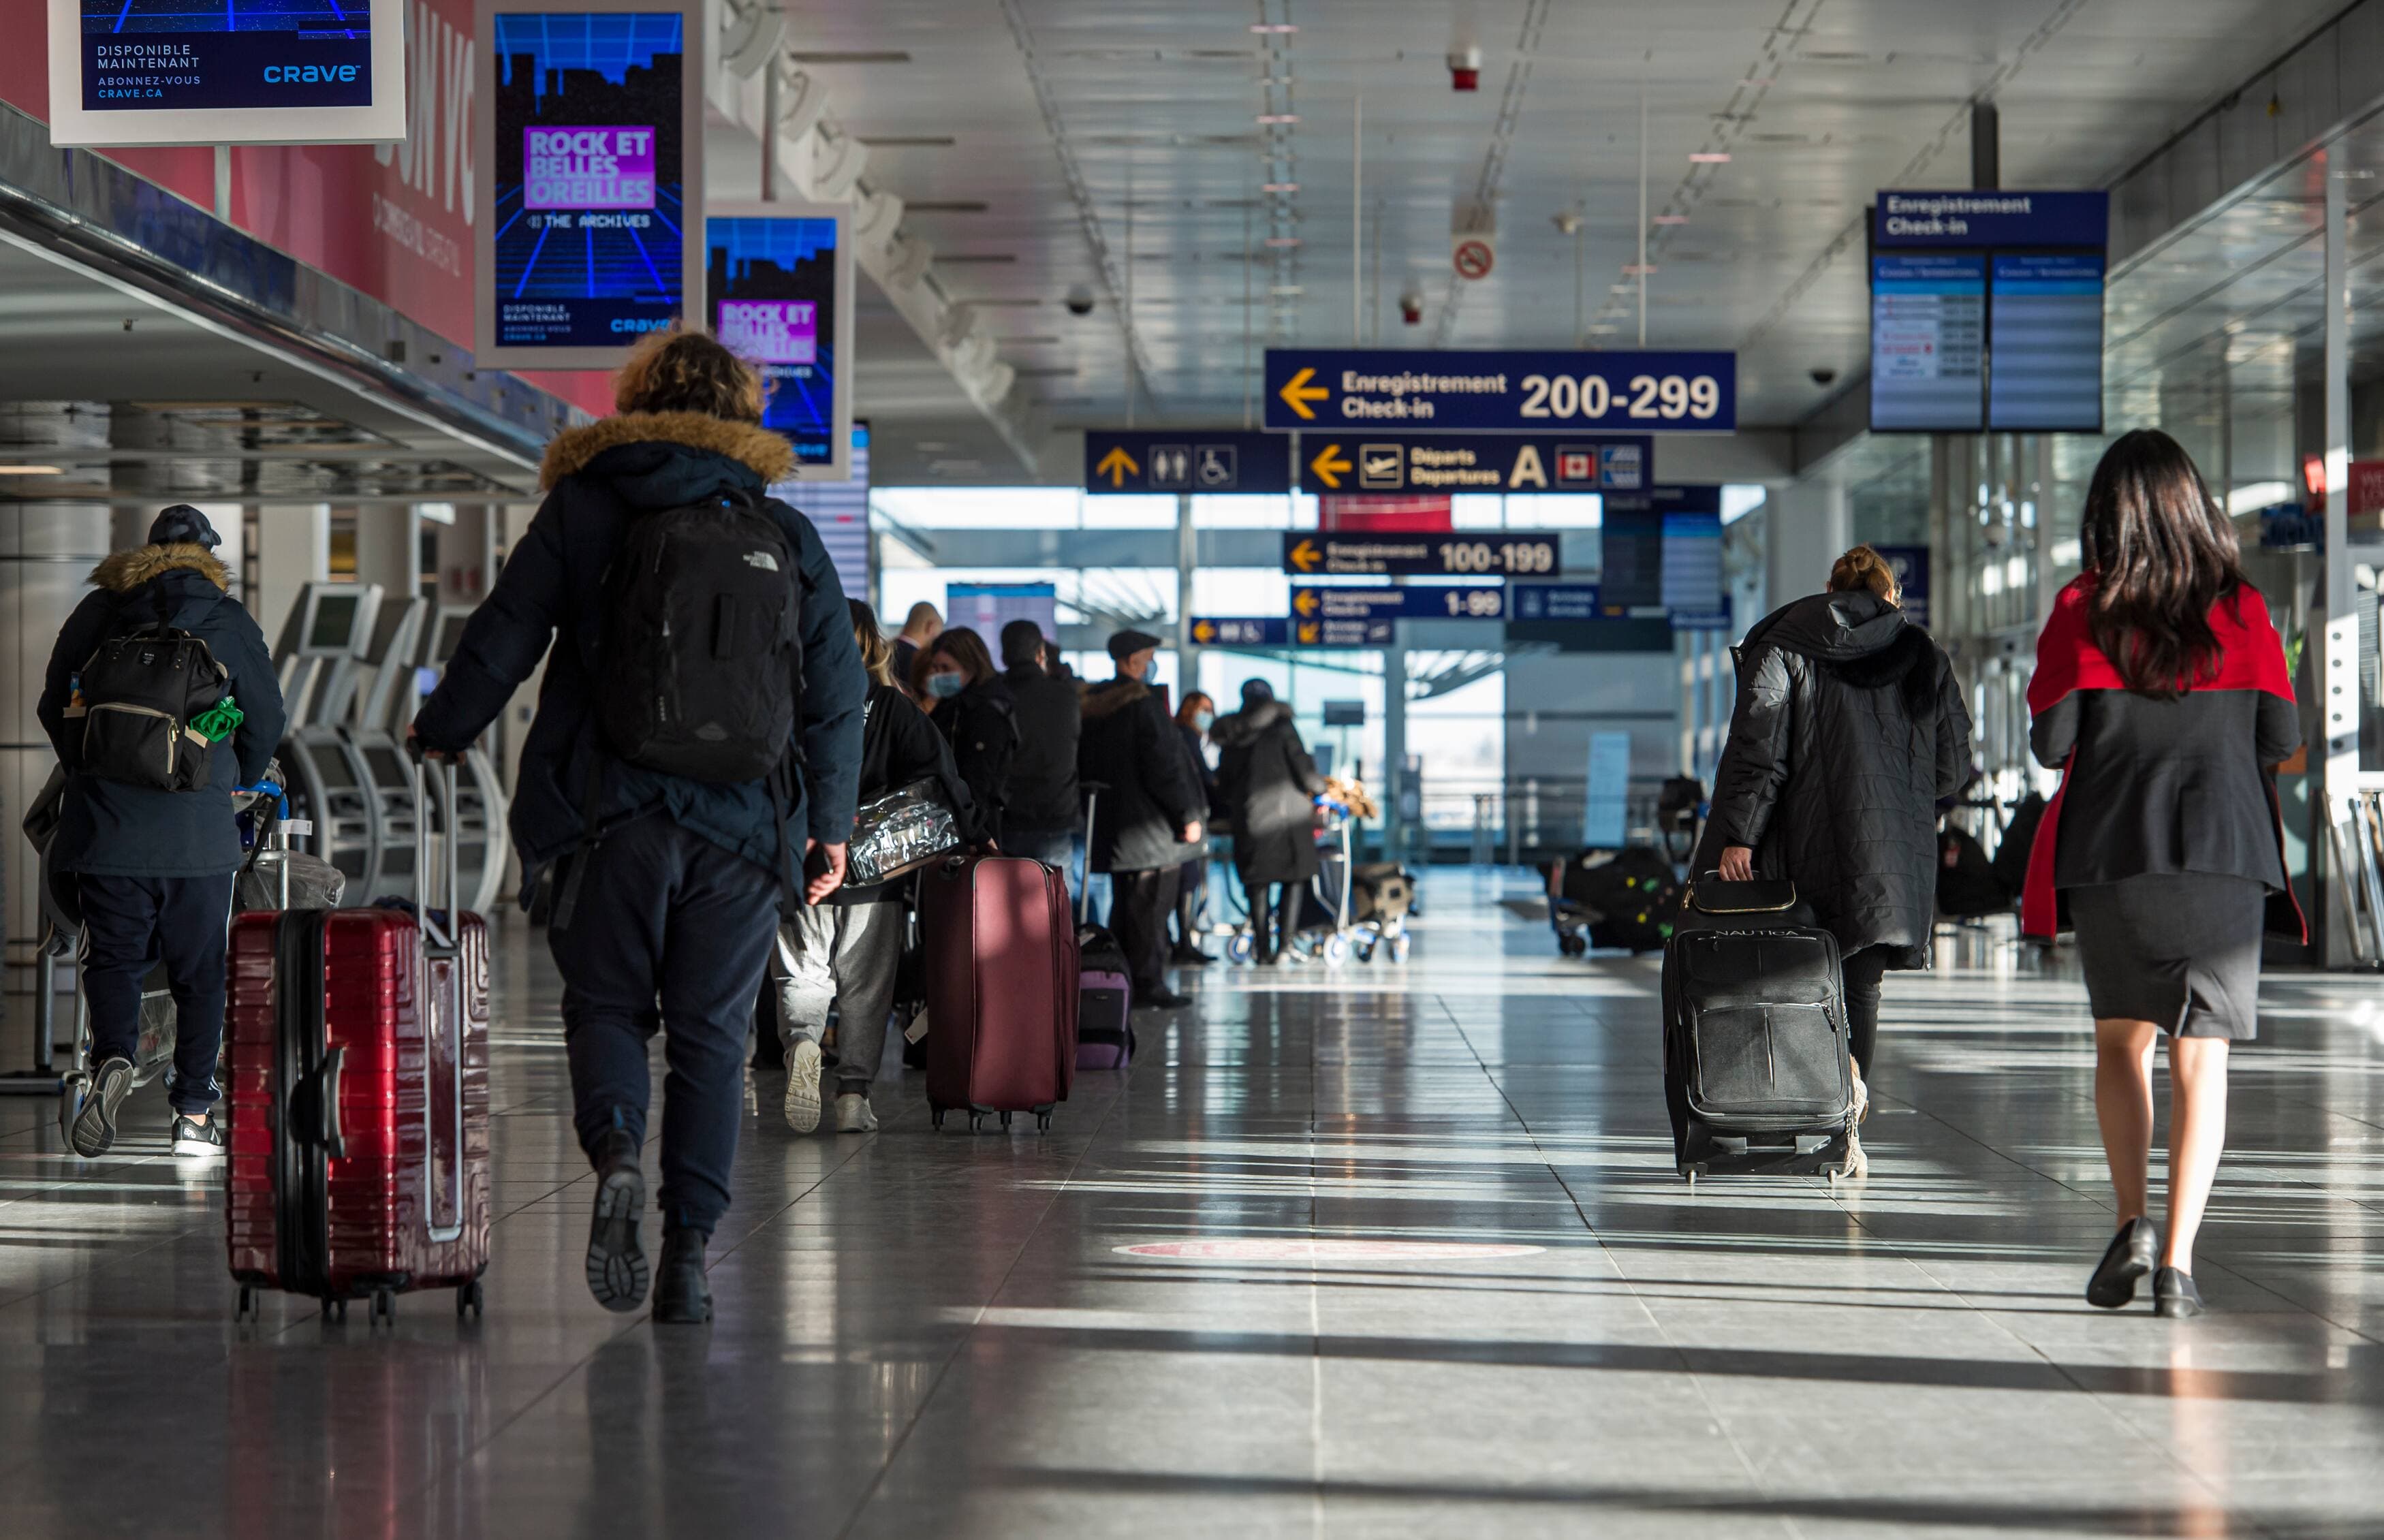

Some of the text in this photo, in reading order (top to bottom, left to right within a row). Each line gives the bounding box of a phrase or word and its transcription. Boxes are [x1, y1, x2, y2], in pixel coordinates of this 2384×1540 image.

[97, 45, 190, 57] DISPONIBLE
[97, 57, 200, 69] MAINTENANT
[98, 76, 201, 86] ABONNEZ-VOUS
[98, 89, 163, 98] CRAVE.CA
[529, 131, 651, 156] ROCK ET
[531, 155, 620, 179] BELLES
[531, 179, 652, 204] OREILLES
[1886, 195, 2032, 216] Enregistrement
[545, 214, 651, 228] THE ARCHIVES
[1886, 217, 1969, 235] Check-in
[1341, 371, 1720, 420] Enregistrement 200-299
[1341, 397, 1435, 418] Check-in
[1411, 444, 1549, 489] Départs A
[1411, 467, 1501, 486] Departures
[1439, 542, 1553, 573] 100-199
[1445, 591, 1502, 616] 1-99
